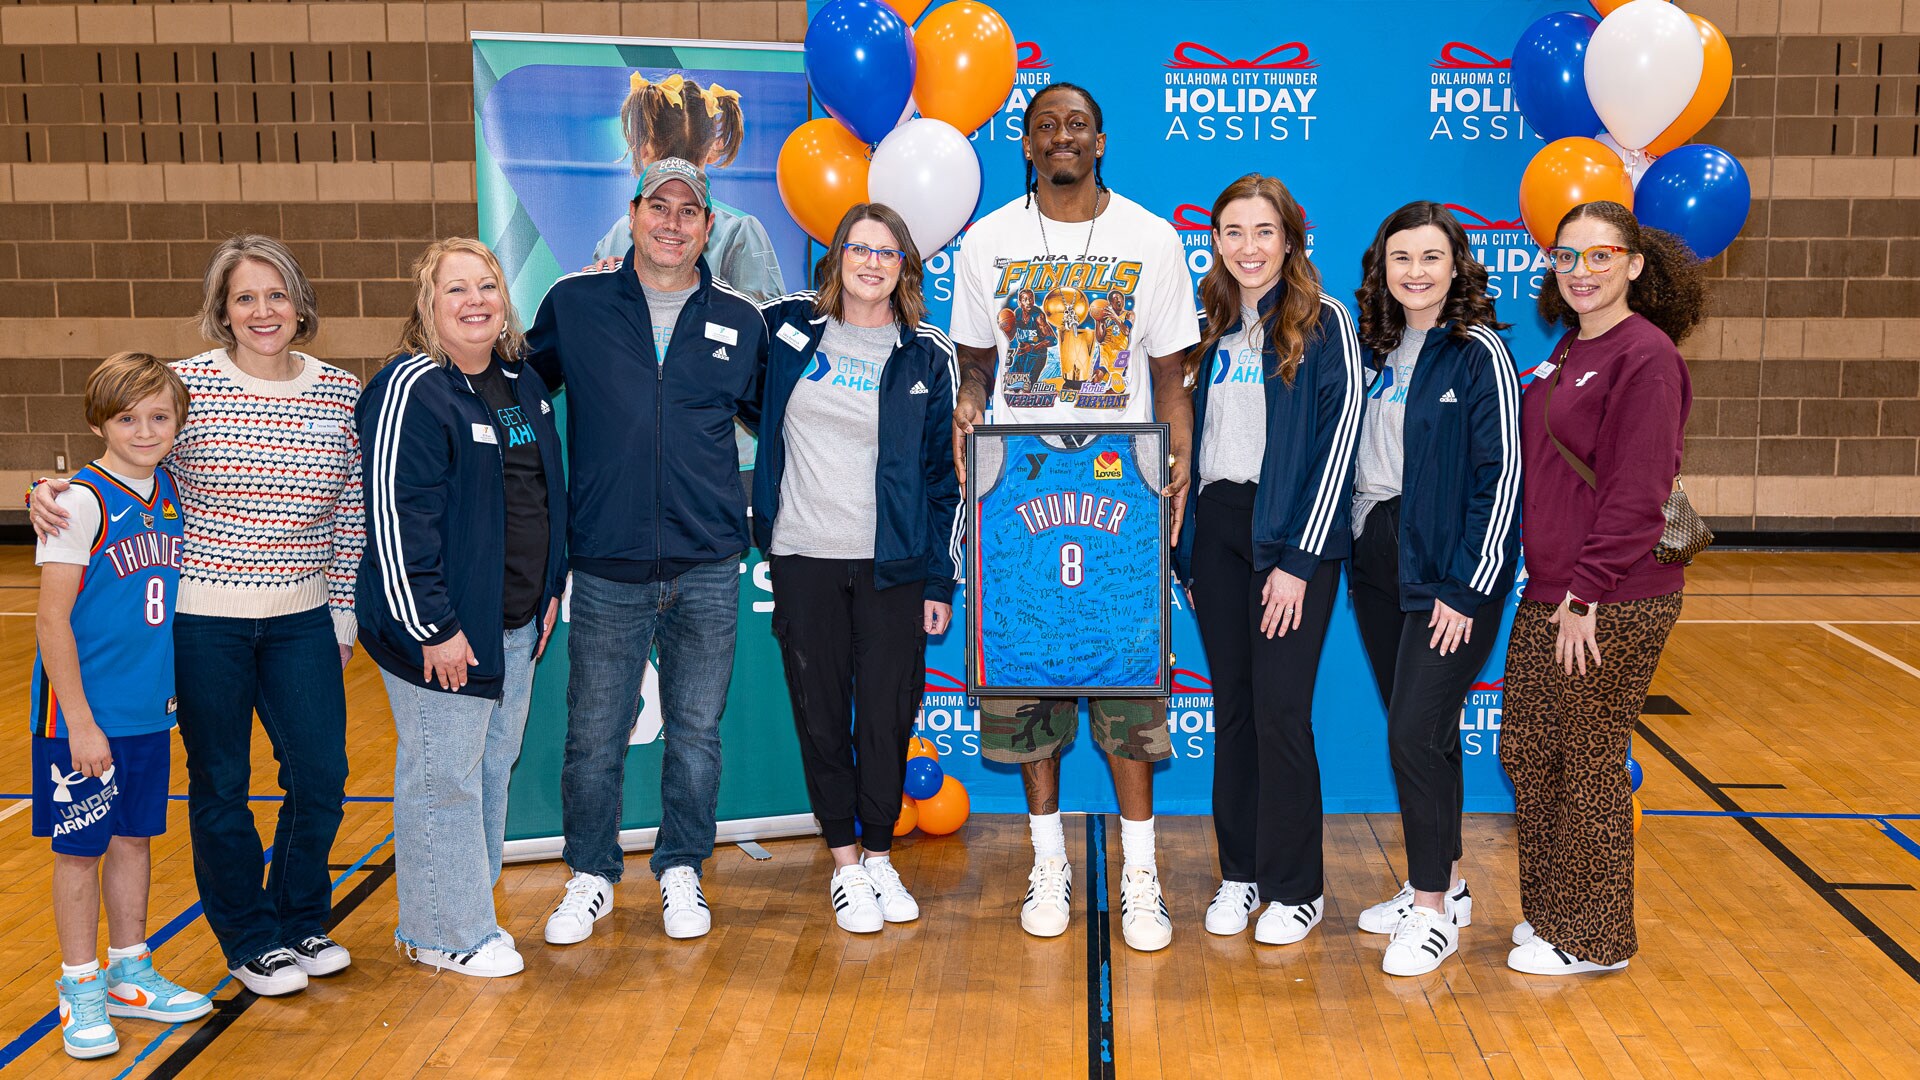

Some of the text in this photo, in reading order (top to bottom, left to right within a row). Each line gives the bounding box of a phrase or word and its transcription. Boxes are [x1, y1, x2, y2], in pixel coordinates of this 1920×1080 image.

[1165, 72, 1318, 85] OKLAHOMA CITY THUNDER
[1431, 72, 1494, 85] OKLAHOMA
[1165, 88, 1317, 113] HOLIDAY
[1165, 116, 1317, 141] ASSIST
[1430, 116, 1544, 140] ASSI
[1492, 233, 1519, 246] CITY
[1032, 254, 1118, 262] NBA 2001
[1470, 248, 1548, 272] LIDA
[994, 260, 1143, 299] FINALS
[1005, 348, 1016, 368] 3
[1114, 350, 1131, 368] 8
[1031, 382, 1056, 392] Allen
[1060, 390, 1078, 402] VS
[1080, 382, 1106, 394] Kobe
[1015, 492, 1128, 535] THUNDER
[104, 531, 182, 579] THUNDE
[1060, 541, 1084, 588] 8
[145, 575, 166, 627] 8
[919, 695, 964, 707] AHOMA
[1472, 694, 1498, 706] CITY
